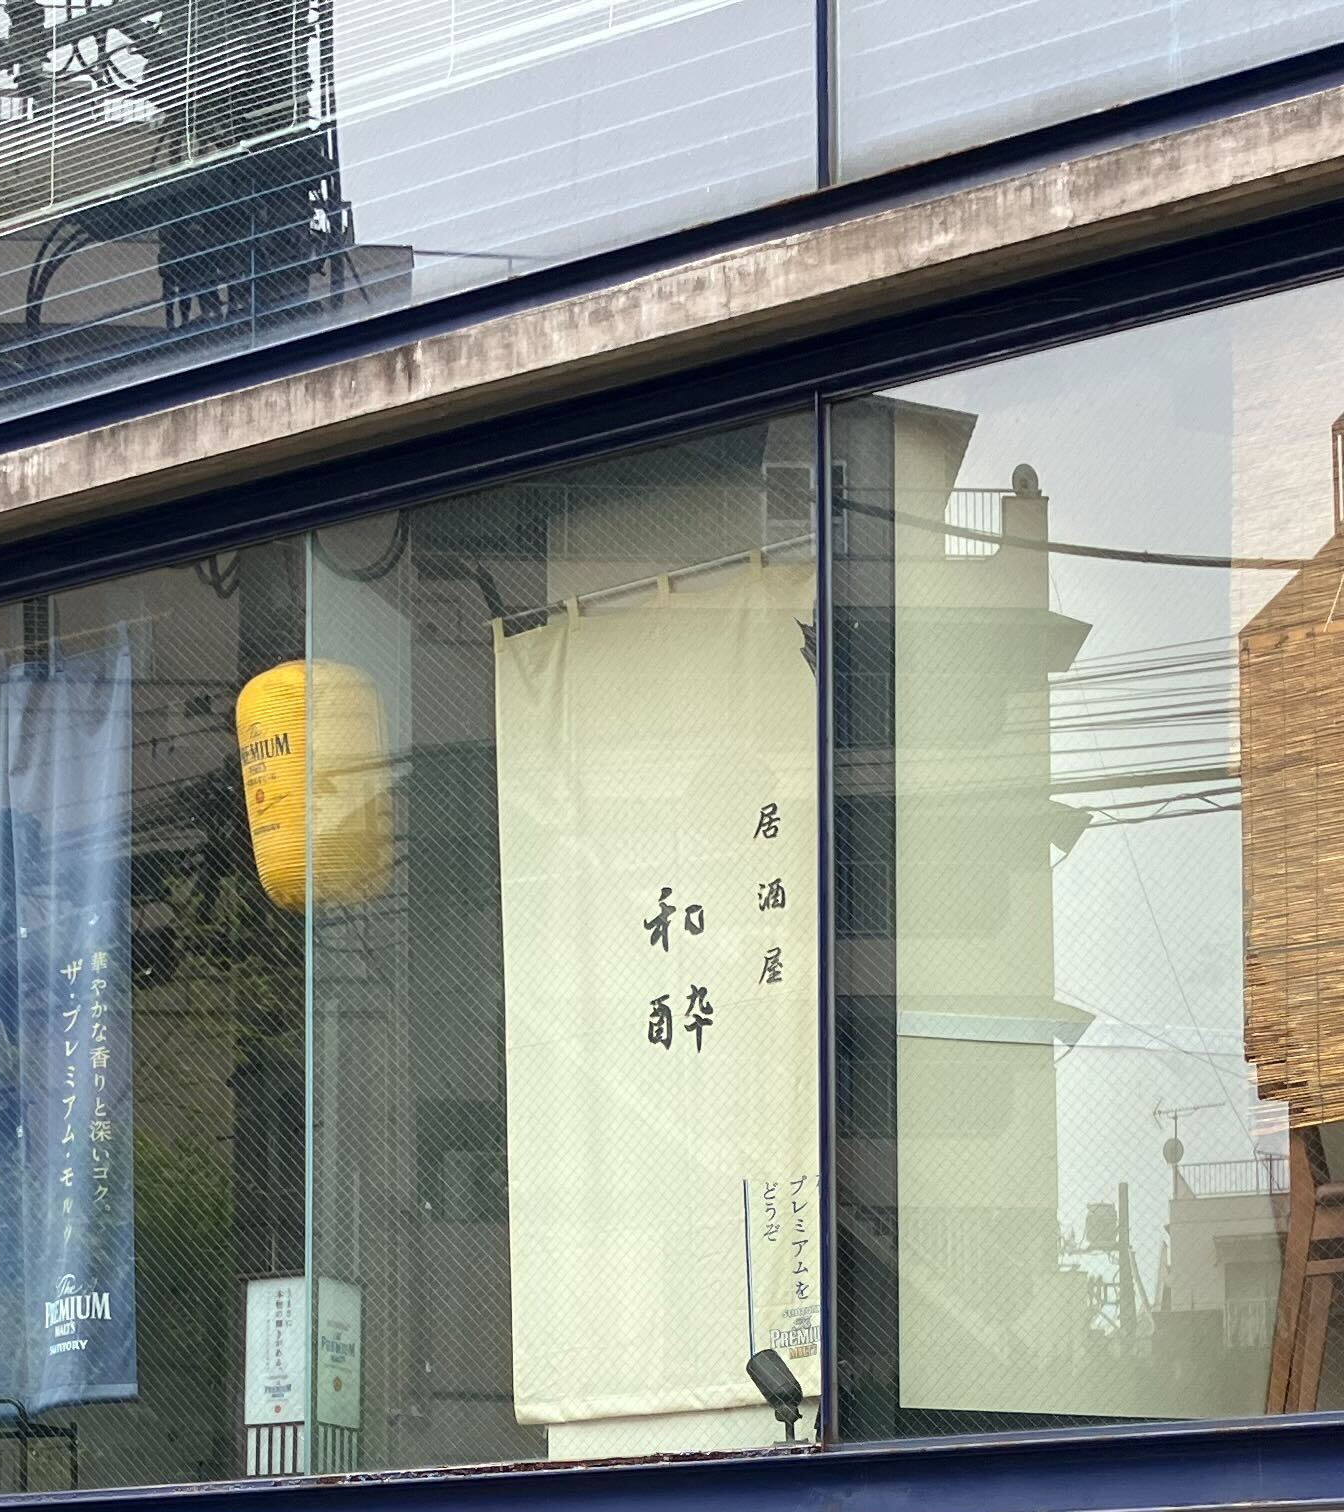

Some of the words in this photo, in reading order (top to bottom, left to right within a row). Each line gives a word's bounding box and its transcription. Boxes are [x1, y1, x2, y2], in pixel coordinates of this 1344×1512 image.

[753, 802, 787, 985] 居酒屋
[89, 951, 112, 1212] 華やかな香りと深いコク。
[763, 1181, 781, 1242] どうぞ
[790, 1175, 810, 1300] プレミアムを
